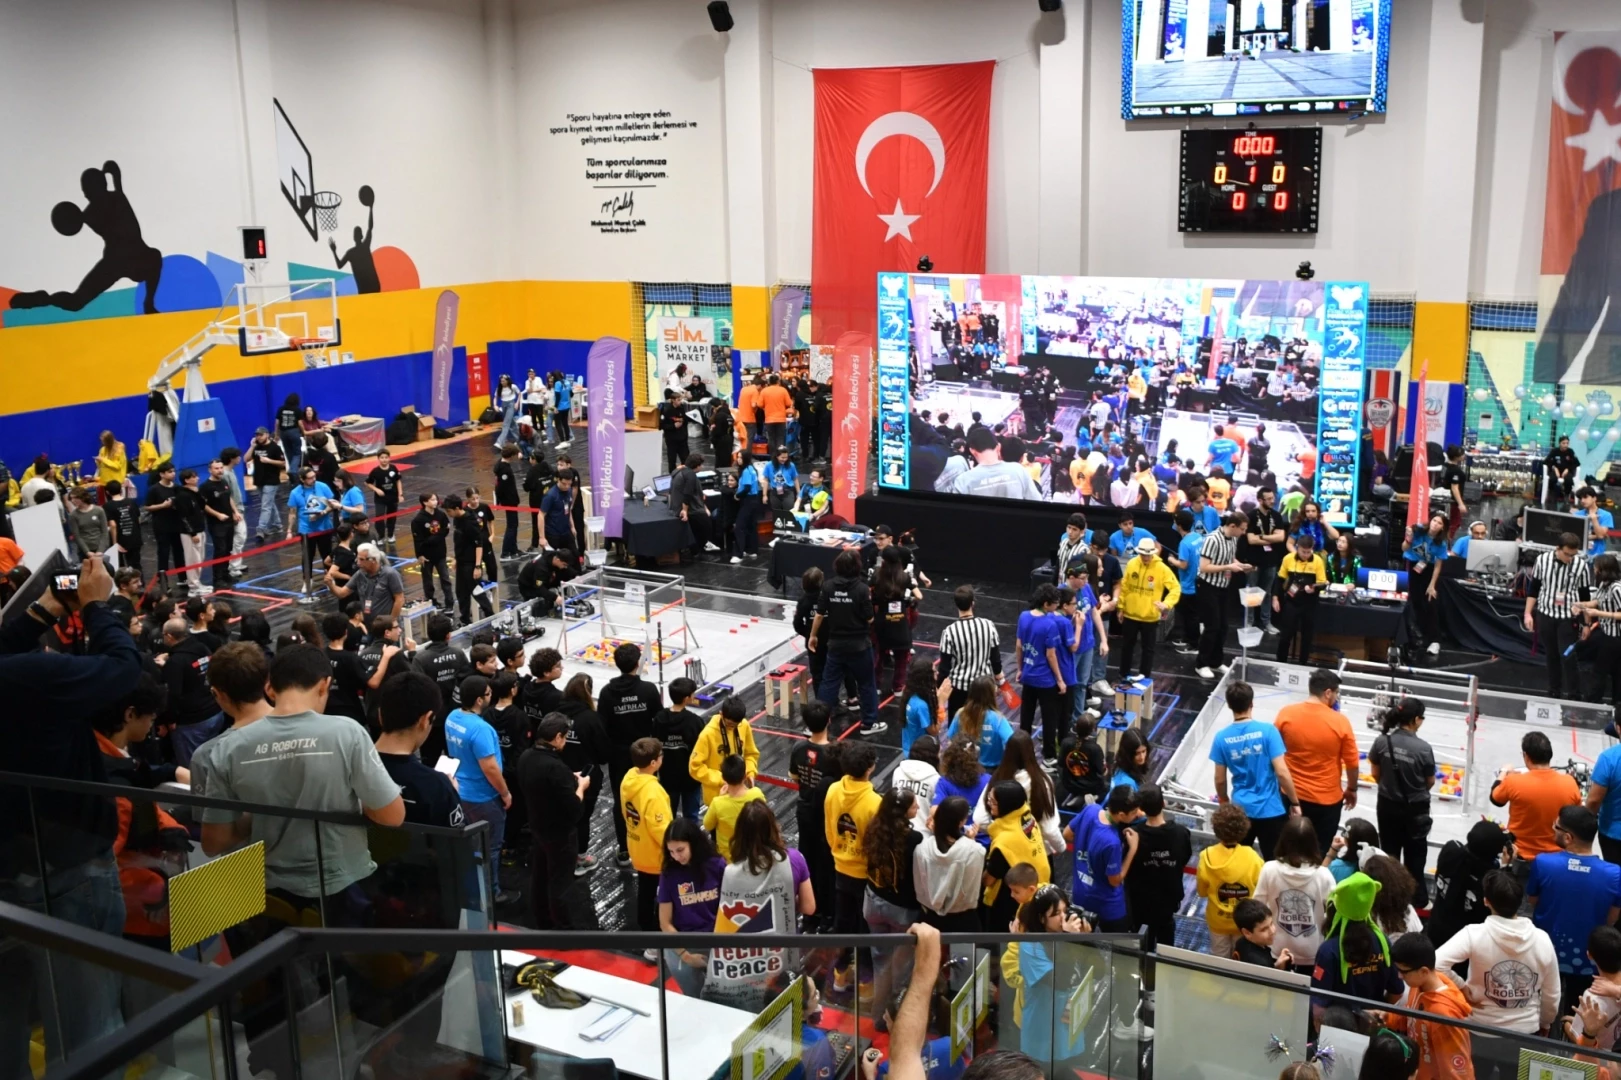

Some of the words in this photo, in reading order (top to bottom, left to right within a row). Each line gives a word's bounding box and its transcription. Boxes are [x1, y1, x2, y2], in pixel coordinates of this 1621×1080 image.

[624, 111, 651, 120] entegre
[653, 109, 671, 118] eden
[549, 127, 568, 135] spora
[569, 124, 593, 135] kıymet
[615, 122, 650, 131] milletlerin
[581, 134, 612, 146] gelişmesi
[586, 158, 603, 167] Tüm
[1214, 166, 1227, 183] 0
[1250, 166, 1256, 183] 1
[1272, 165, 1285, 183] 0
[1232, 192, 1245, 210] 0
[1274, 192, 1287, 210] 0
[781, 302, 793, 340] Belediyesi
[664, 344, 683, 353] SML
[686, 345, 708, 353] YAPI
[667, 353, 706, 362] MARKET
[603, 359, 616, 416] Belediyesi
[848, 353, 860, 410] Belediyesi
[600, 446, 617, 509] Beylikdüzü
[847, 439, 859, 500] Beylikdüzü
[254, 743, 269, 755] AG
[271, 737, 319, 753] ROBOTIK
[1280, 913, 1312, 923] ROBEST
[713, 956, 782, 979] Peace
[1492, 987, 1531, 998] ROBEST
